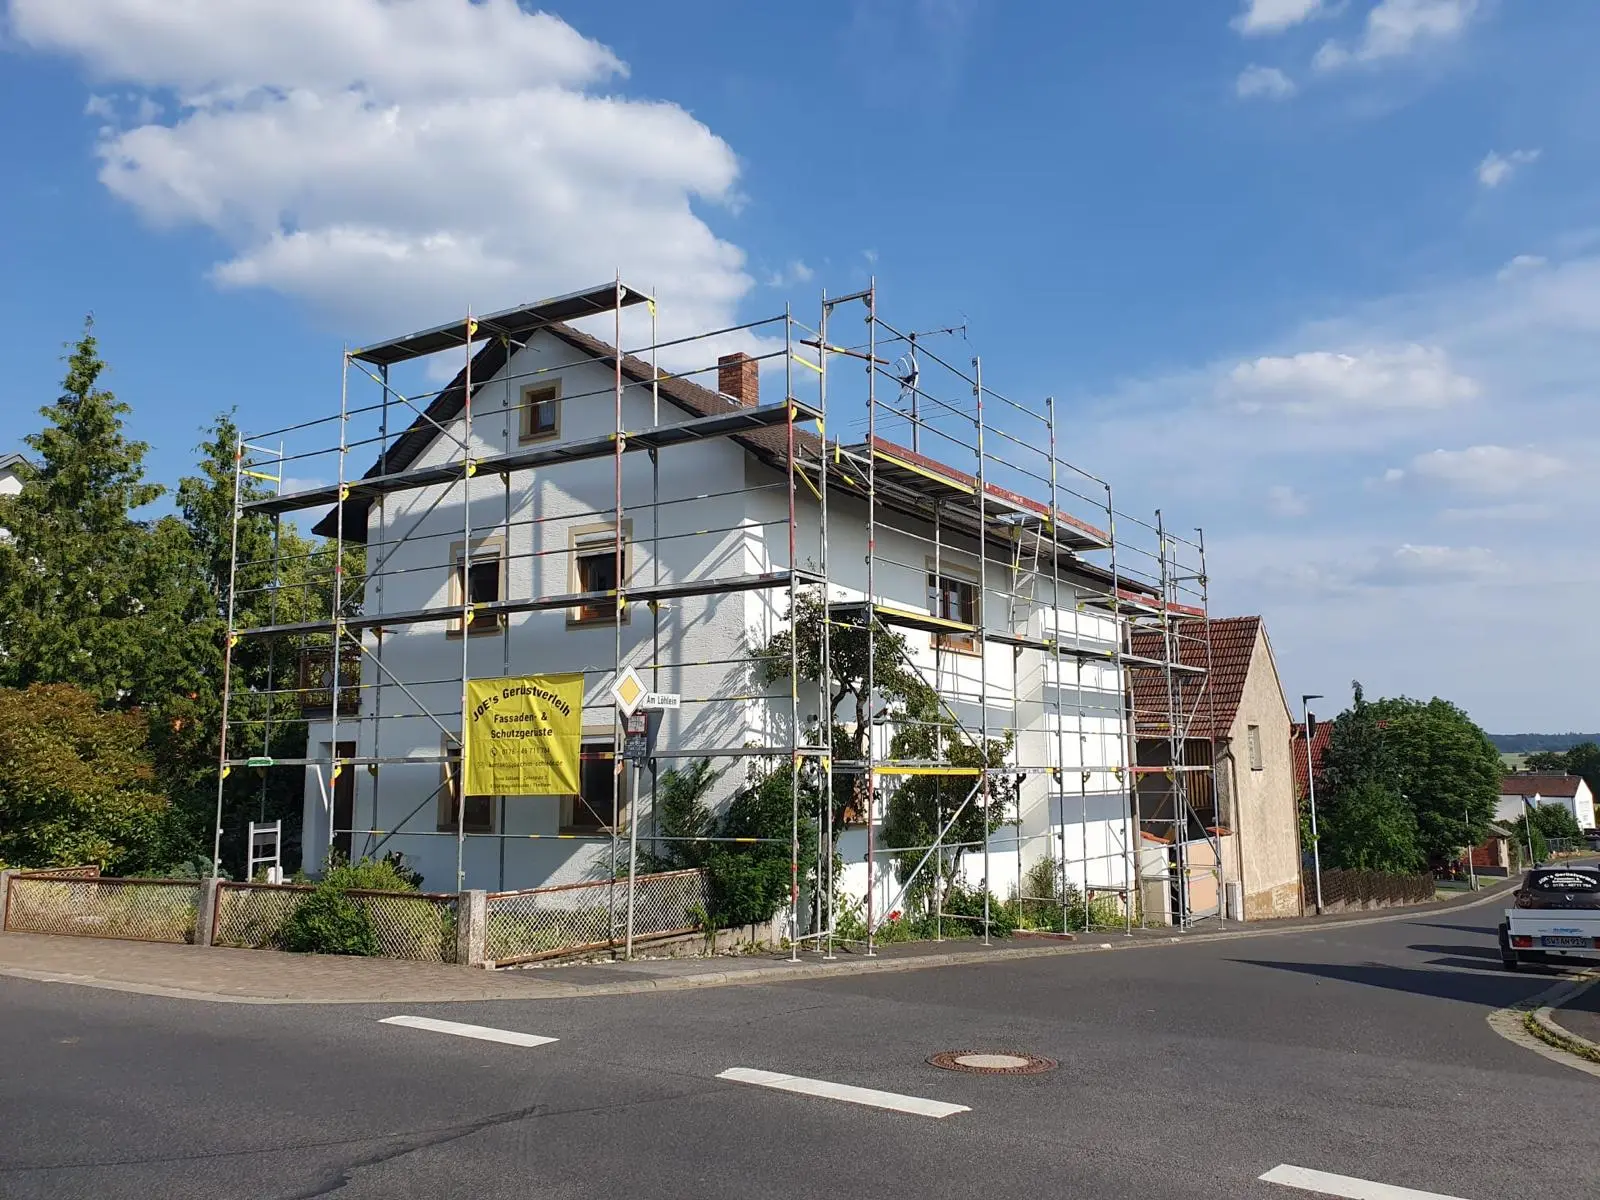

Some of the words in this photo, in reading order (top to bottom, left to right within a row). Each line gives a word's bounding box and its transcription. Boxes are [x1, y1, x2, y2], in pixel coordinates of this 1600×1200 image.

[473, 696, 499, 721] JOE's
[502, 685, 571, 717] Gerüstverleih
[646, 695, 656, 704] Am
[657, 695, 677, 705] Löhlein
[494, 712, 537, 723] Fassaden-
[541, 711, 548, 721] &
[490, 727, 553, 740] Schutzgerüste
